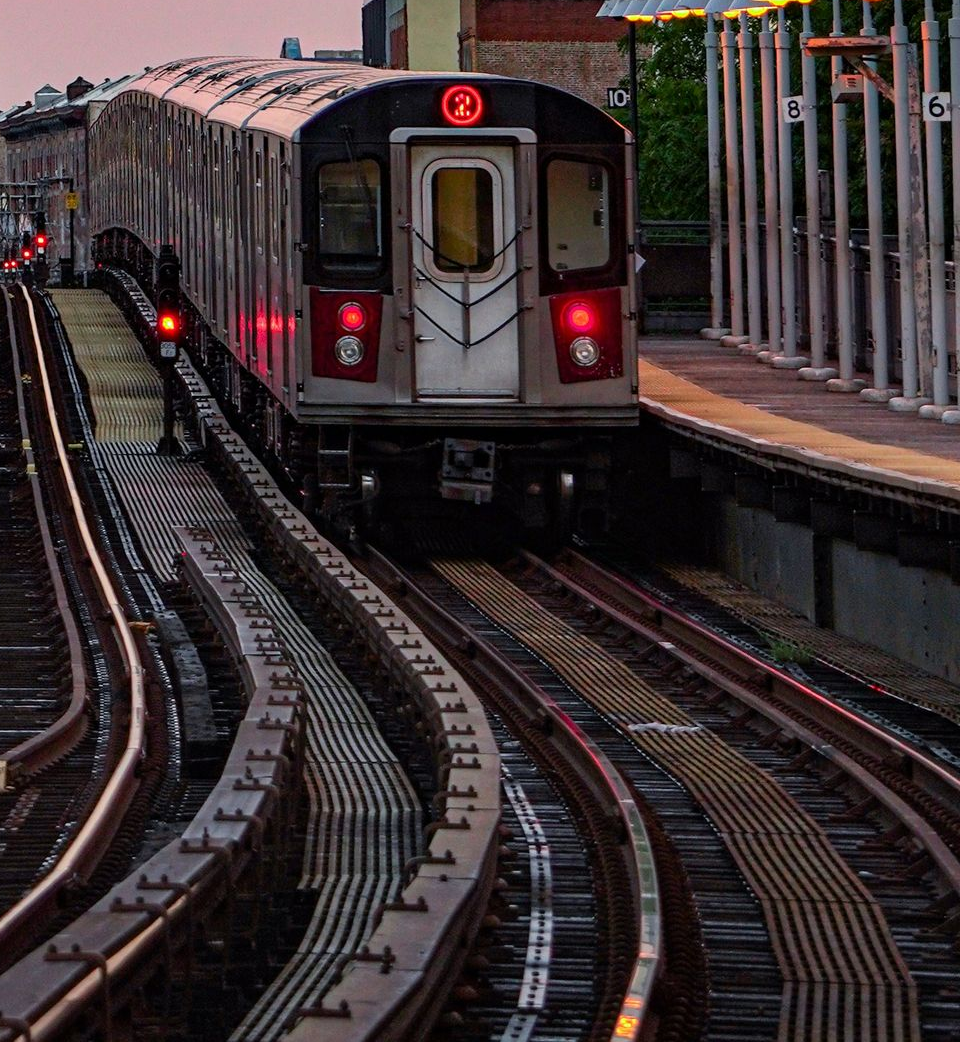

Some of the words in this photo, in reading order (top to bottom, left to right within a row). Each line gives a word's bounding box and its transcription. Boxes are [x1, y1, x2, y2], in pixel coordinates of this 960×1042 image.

[608, 89, 627, 107] 10
[928, 95, 945, 118] 6
[787, 99, 800, 119] 8
